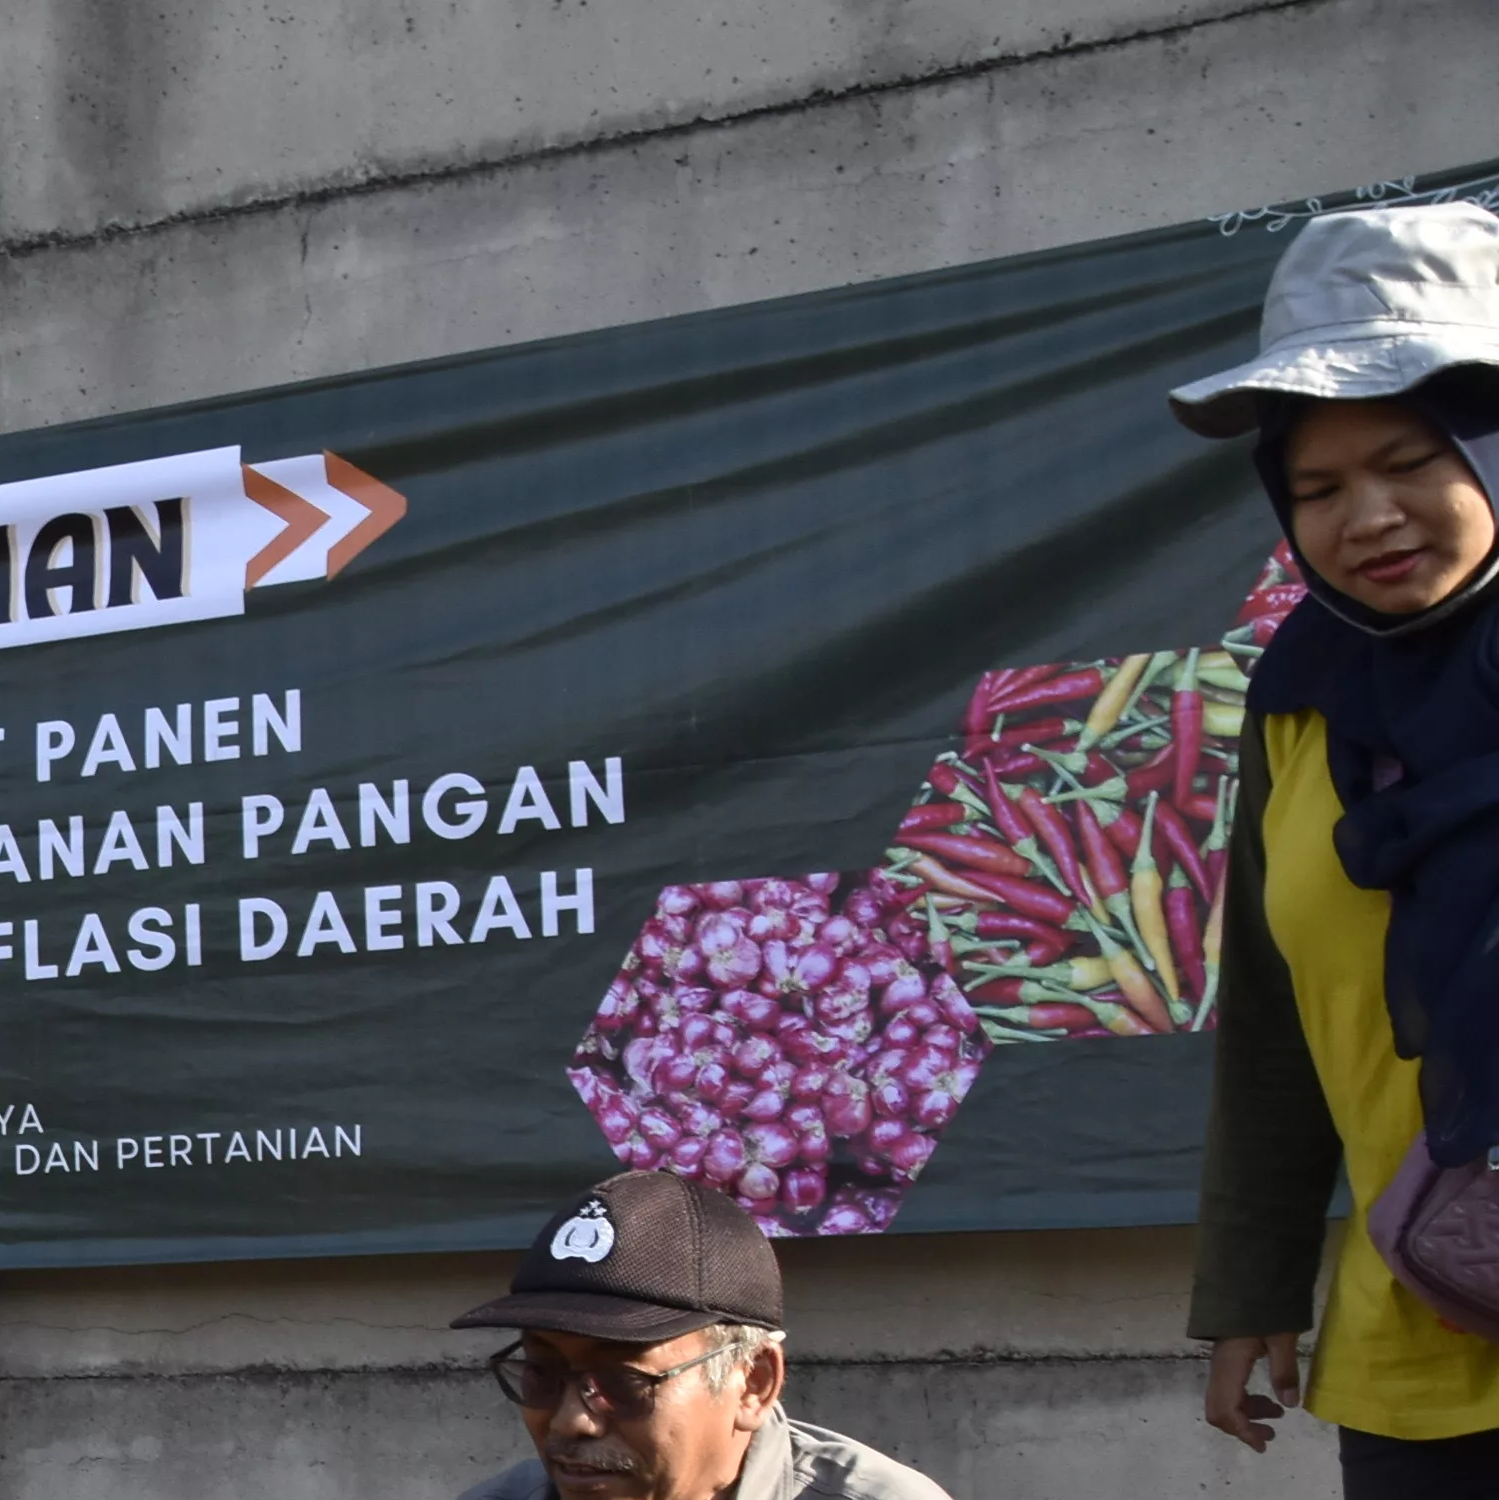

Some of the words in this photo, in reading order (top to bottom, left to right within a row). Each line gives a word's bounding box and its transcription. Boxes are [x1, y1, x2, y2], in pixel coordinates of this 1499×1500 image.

[37, 689, 301, 782] PANEN
[242, 757, 624, 858] PANGAN
[239, 868, 594, 961] DAERAH
[16, 1140, 98, 1174] DAN
[118, 1125, 360, 1168] PERTANIAN
